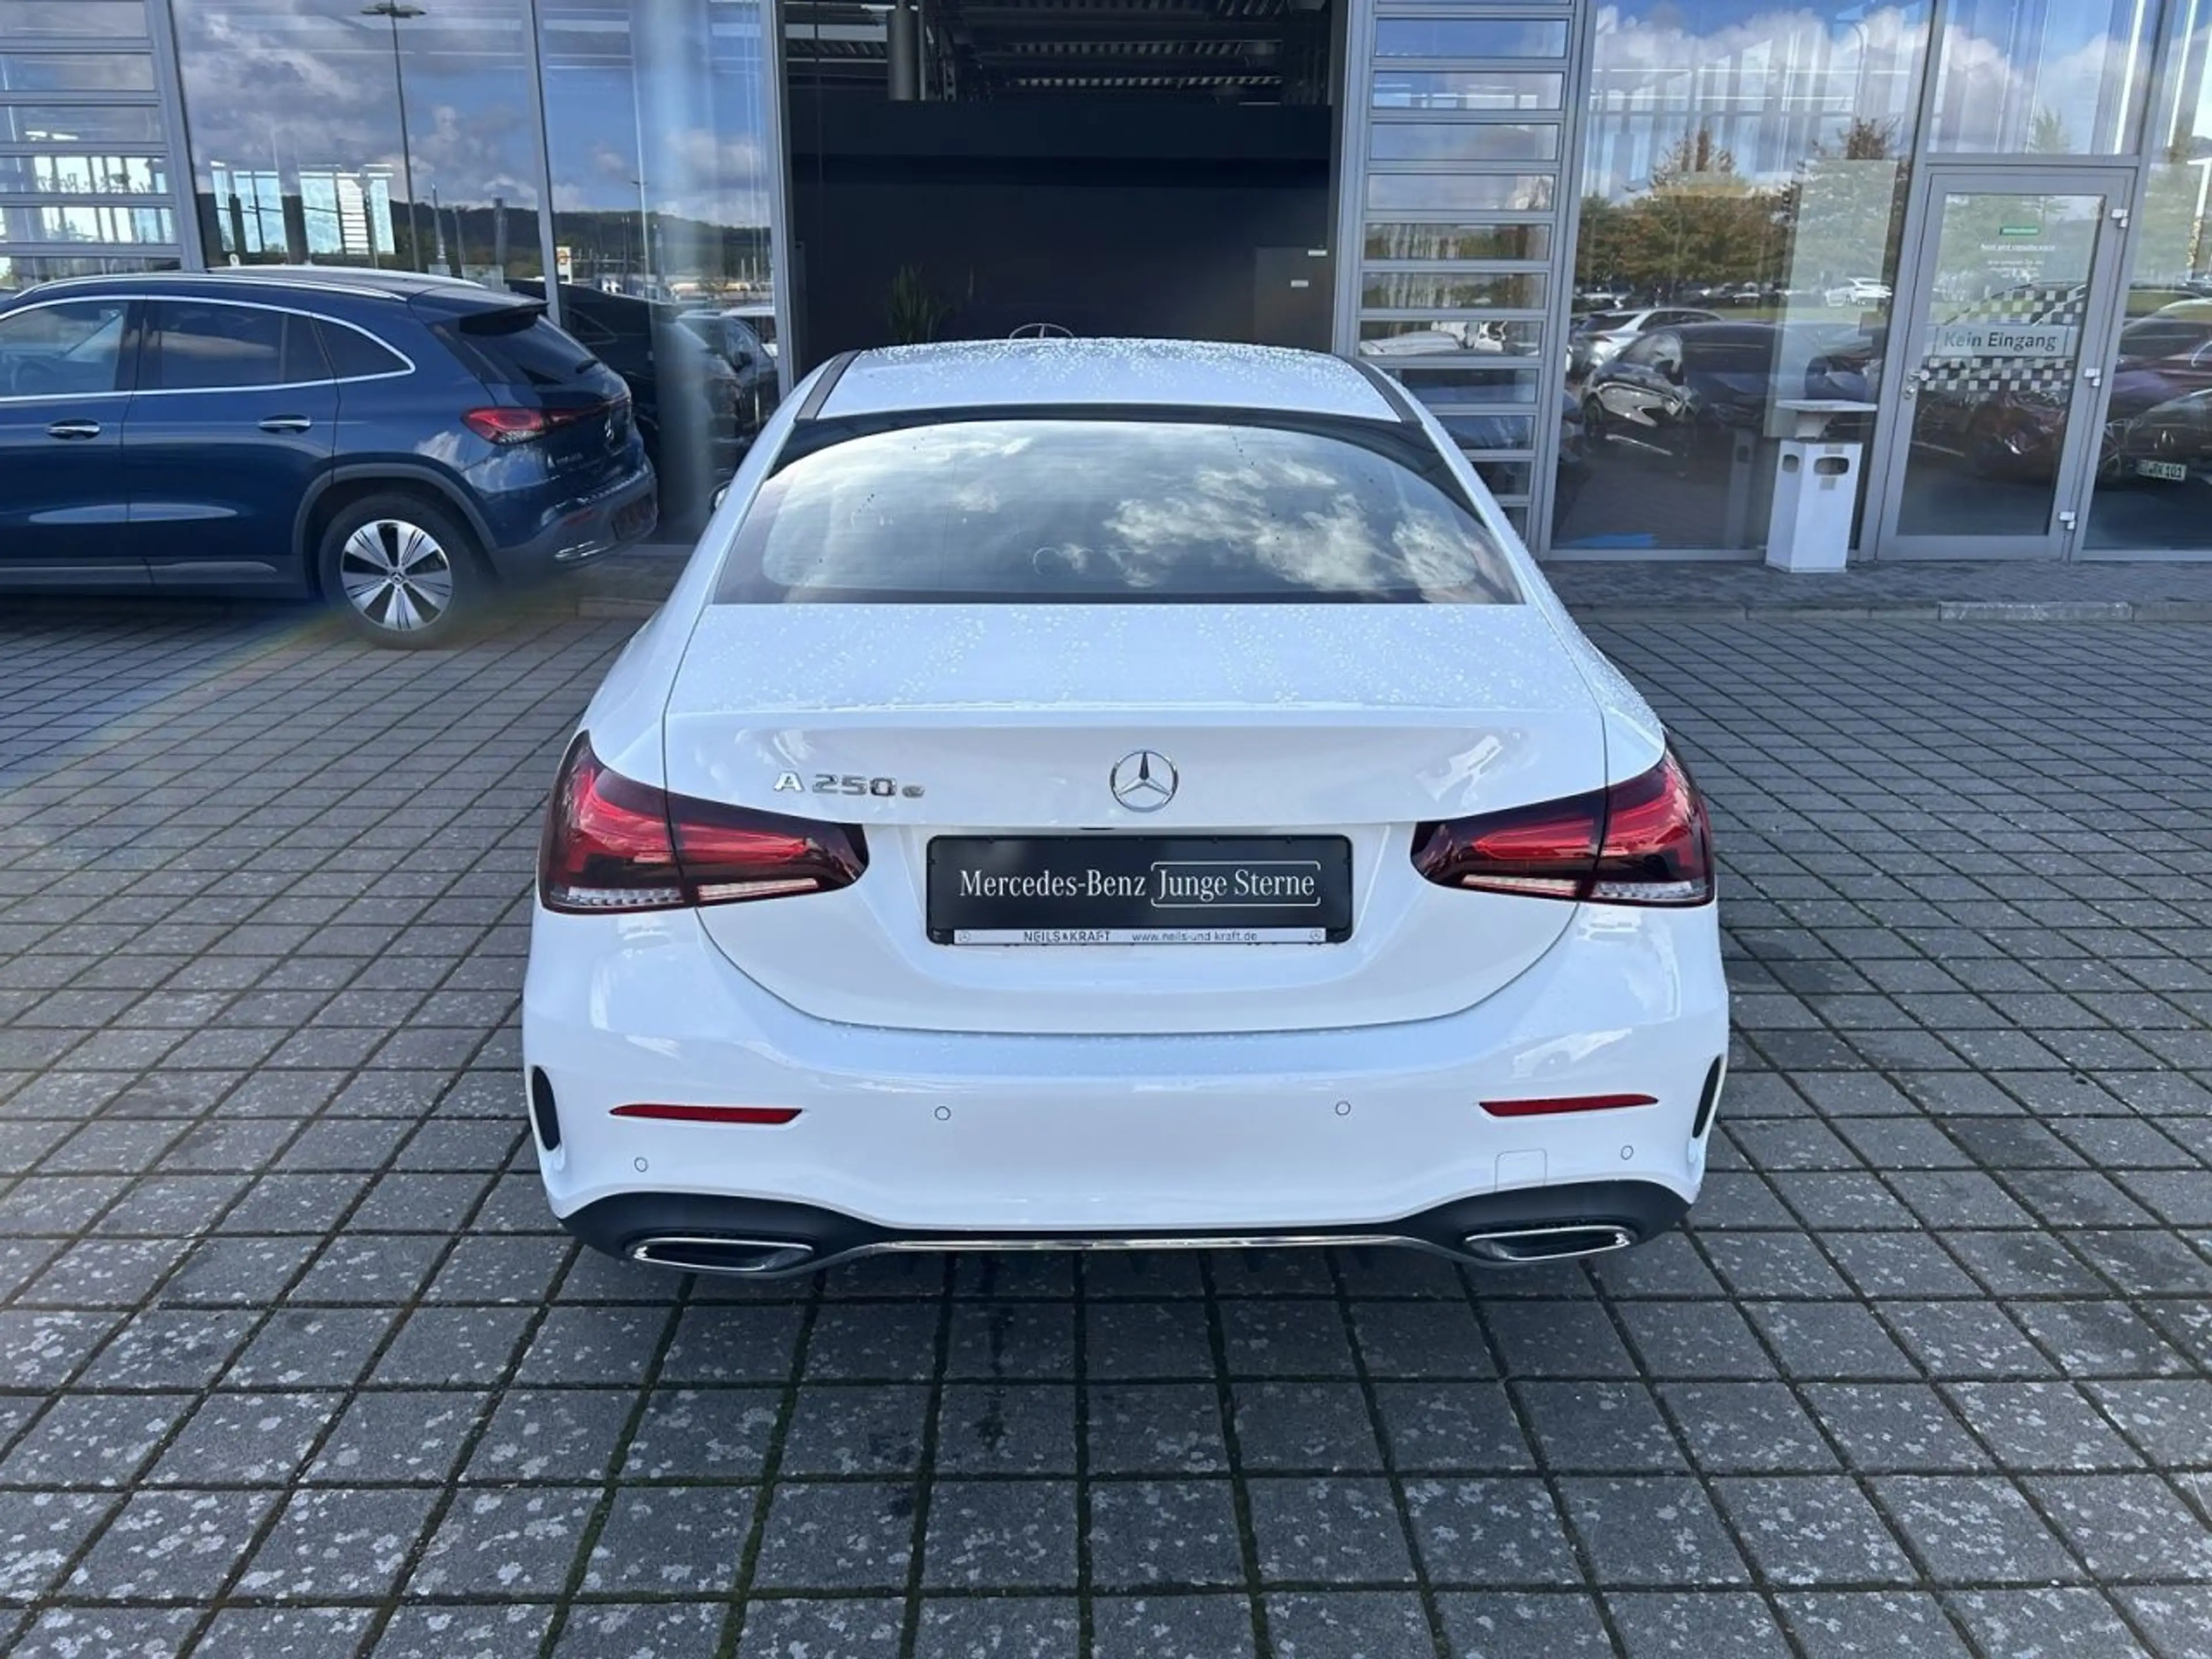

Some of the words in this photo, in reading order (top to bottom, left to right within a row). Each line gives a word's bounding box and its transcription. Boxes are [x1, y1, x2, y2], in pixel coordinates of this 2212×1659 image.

[1944, 331, 1982, 347] Kein
[1988, 331, 2058, 352] Eingang
[774, 771, 805, 792] A
[812, 774, 897, 797] 250
[960, 869, 1146, 896] Mercedes-Benz
[1158, 869, 1228, 902] Junge
[1234, 869, 1315, 896] Sterne
